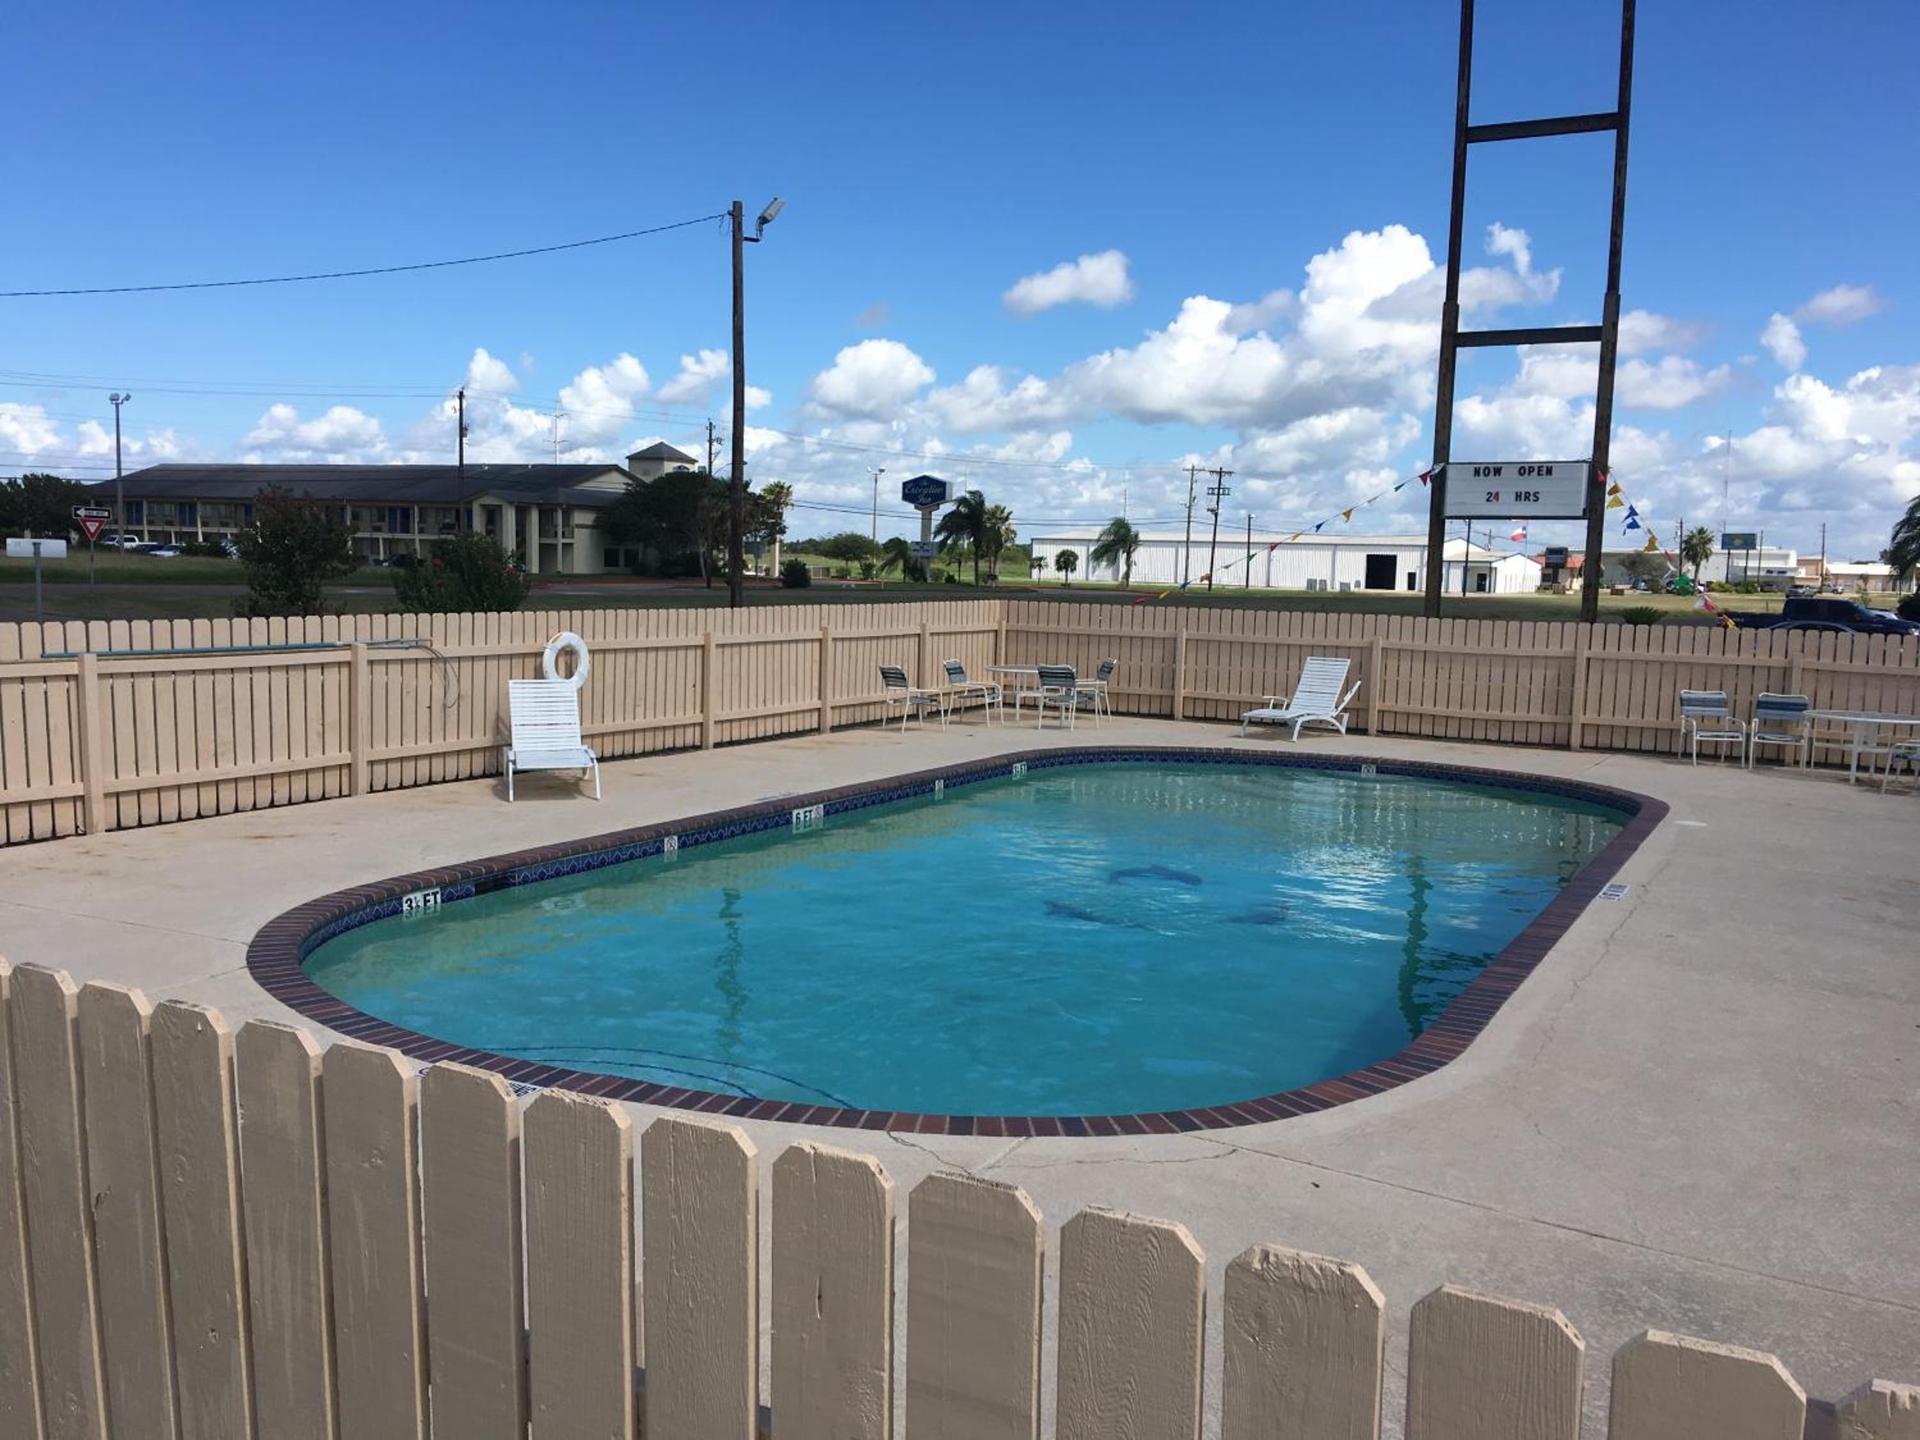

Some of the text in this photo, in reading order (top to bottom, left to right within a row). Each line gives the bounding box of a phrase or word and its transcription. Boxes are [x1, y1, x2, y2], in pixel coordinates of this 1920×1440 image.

[1473, 465, 1553, 477] NOW OPEN
[1486, 491, 1540, 502] 24 HRS
[423, 891, 440, 907] FT
